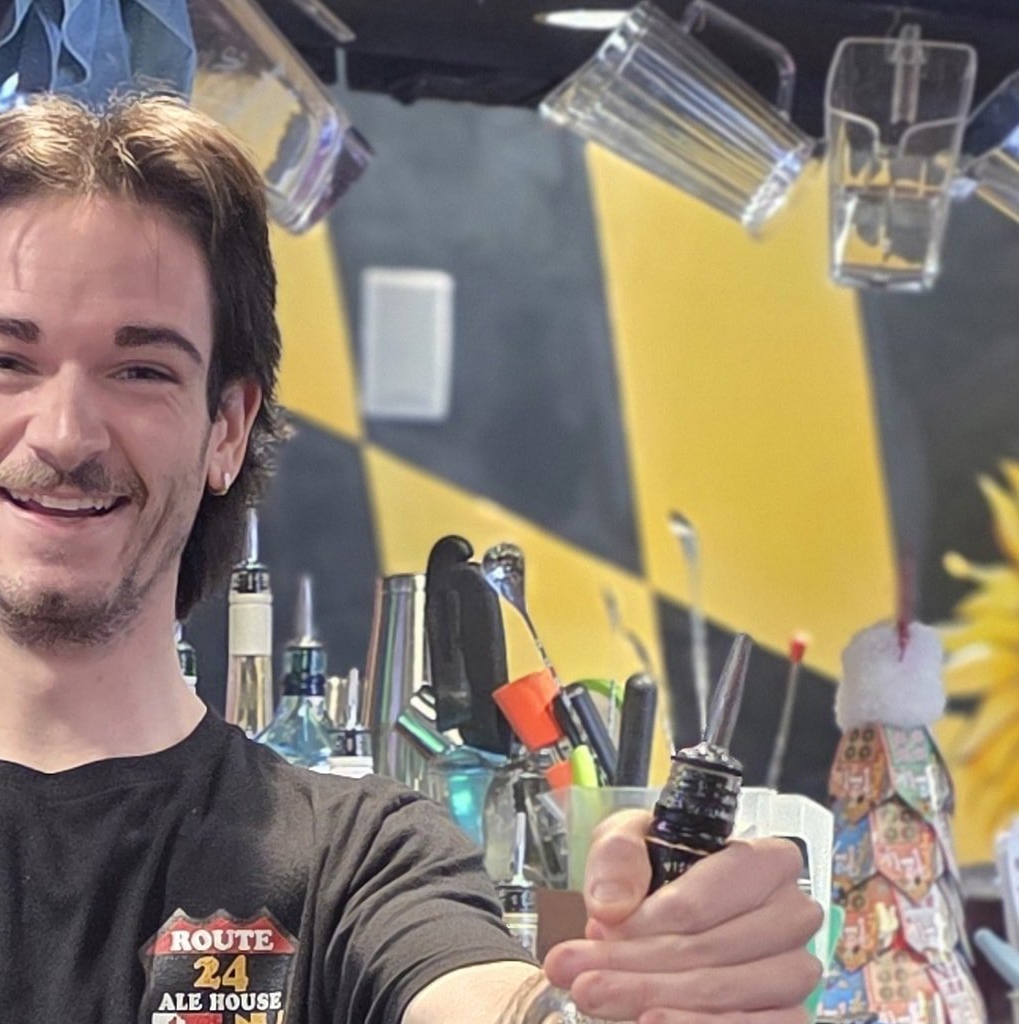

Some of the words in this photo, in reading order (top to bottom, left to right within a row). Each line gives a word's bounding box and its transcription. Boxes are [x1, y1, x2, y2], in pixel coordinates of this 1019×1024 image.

[169, 929, 274, 951] ROUTE
[193, 954, 249, 992] 24
[158, 993, 203, 1012] ALE
[209, 992, 282, 1012] HOUSE
